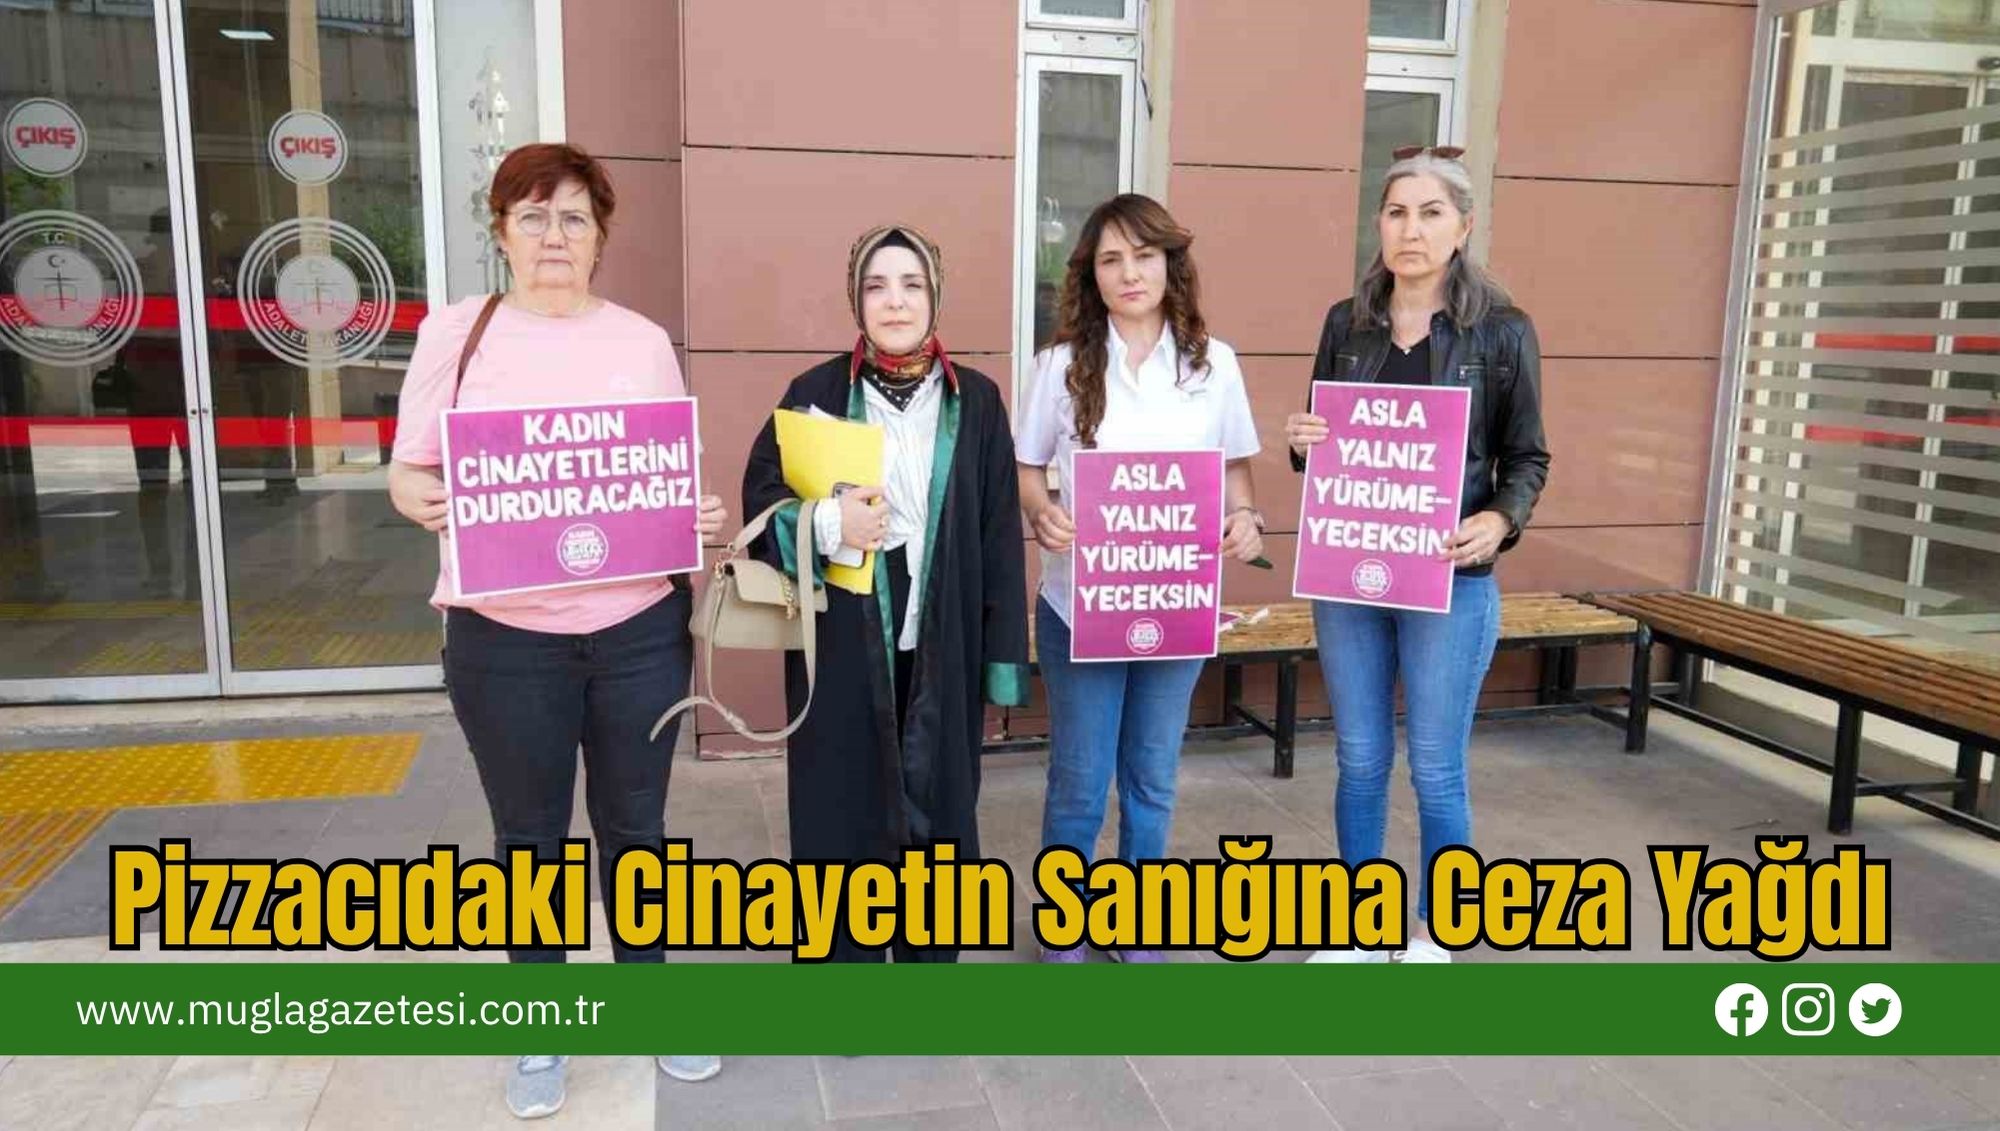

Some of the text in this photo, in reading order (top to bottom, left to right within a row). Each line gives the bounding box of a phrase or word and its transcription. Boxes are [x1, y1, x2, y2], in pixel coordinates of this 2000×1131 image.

[16, 126, 76, 149] ÇIKIŞ
[280, 136, 336, 158] ÇIKIŞ
[523, 410, 626, 446] KADIN
[1350, 398, 1427, 429] ASLA
[457, 436, 689, 489] CİNAYETLERİNİ
[1337, 438, 1437, 472] YALNIZ
[1110, 463, 1186, 492] ASLA
[1313, 474, 1452, 513] YÜRÜME-
[455, 475, 694, 527] DURDURACAĞIZ
[1100, 504, 1197, 532] YALNIZ
[1307, 516, 1450, 557] YECEKSİN
[1081, 540, 1214, 573] YÜRÜME-
[1078, 580, 1214, 612] YECEKSİN
